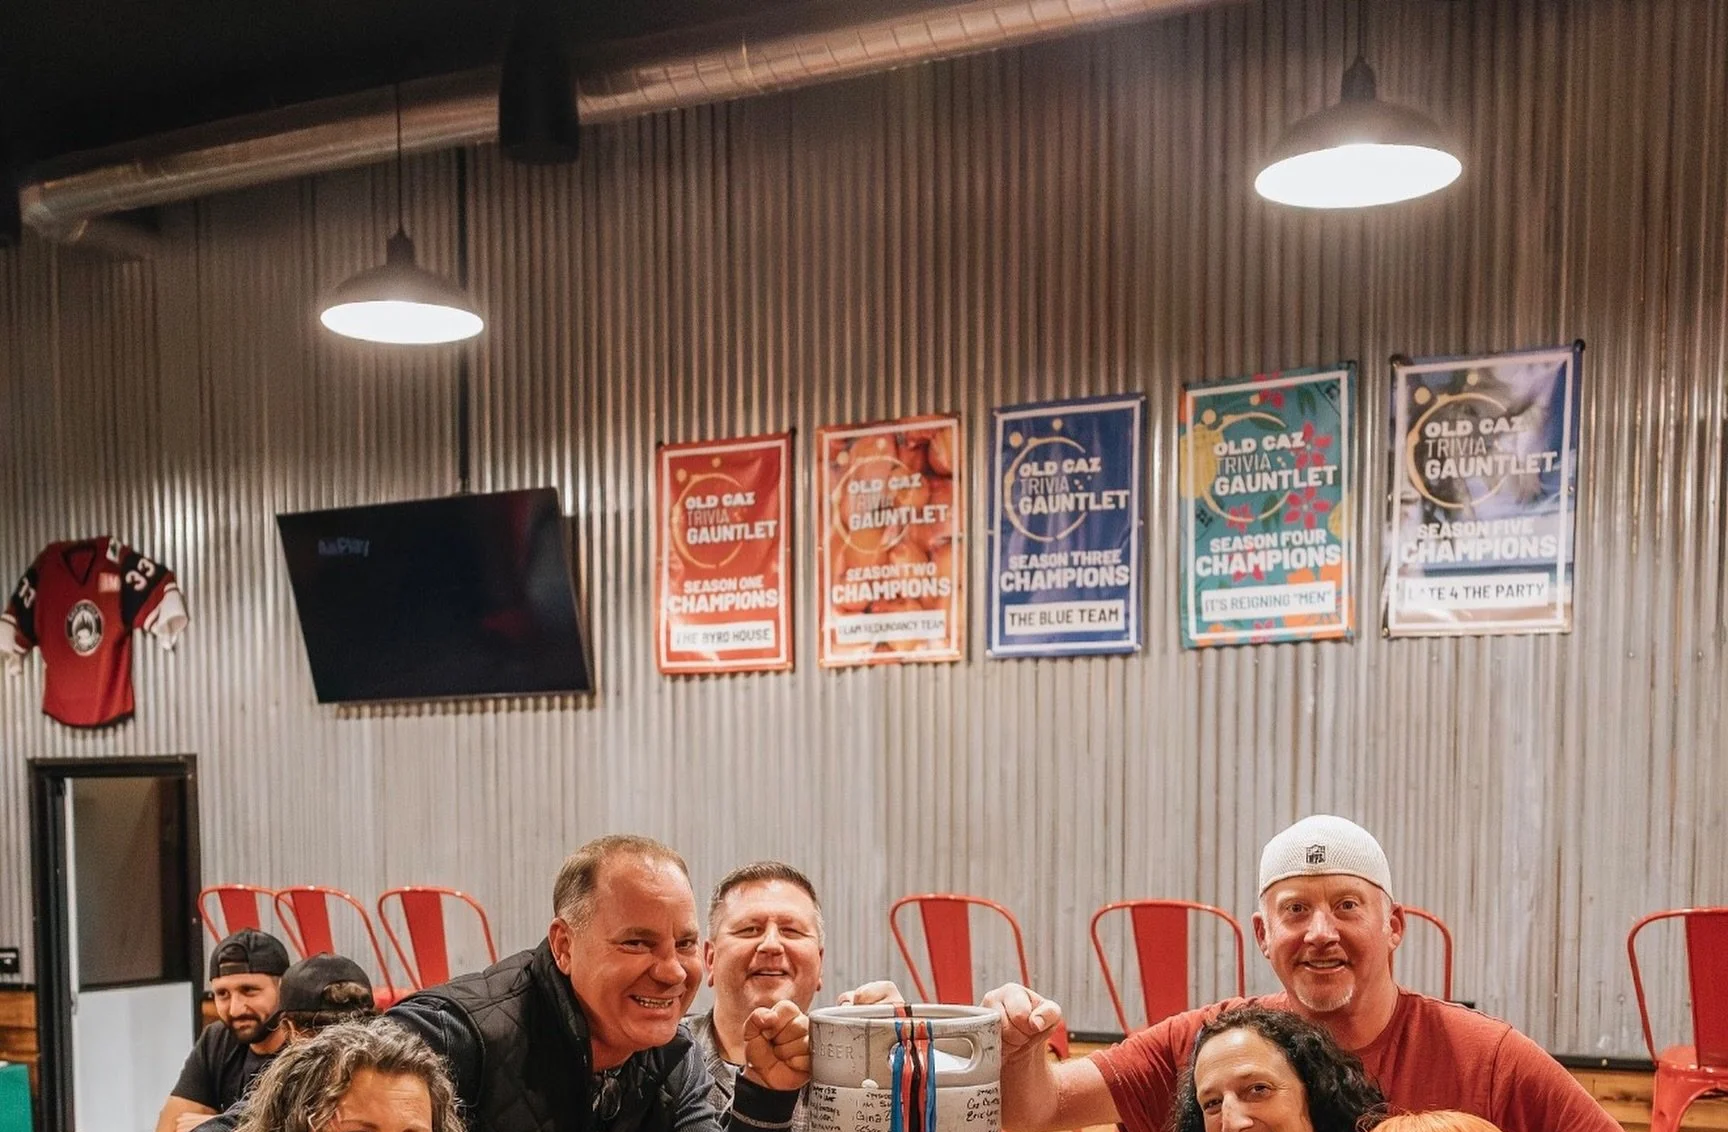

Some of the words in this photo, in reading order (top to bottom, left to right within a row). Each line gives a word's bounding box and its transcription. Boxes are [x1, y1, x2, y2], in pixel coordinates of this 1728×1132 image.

[1425, 419, 1473, 438] OLD
[1214, 437, 1257, 456] OLD
[1262, 432, 1305, 451] CAZ
[1425, 436, 1487, 459] TRIVIA
[1019, 460, 1057, 477] OLD
[1216, 452, 1271, 475] TRIVIA
[1425, 452, 1557, 480] GAUNTLET
[848, 479, 883, 494] OLD
[1020, 476, 1070, 495] TRIVIA
[1214, 465, 1337, 496] GAUNTLET
[685, 494, 718, 509] OLD
[1019, 490, 1129, 515] GAUNTLET
[687, 508, 730, 526] TRIVIA
[849, 504, 948, 531] GAUNTLET
[687, 520, 777, 545] GAUNTLET
[1417, 521, 1488, 540] SEASON
[1491, 518, 1534, 536] FIVE
[1210, 532, 1279, 553] SEASON
[1281, 529, 1327, 546] FOUR
[1402, 536, 1557, 564] CHAMPIONS
[1009, 552, 1069, 570] SEASON
[1071, 549, 1122, 566] THREE
[1196, 544, 1341, 577] CHAMPIONS
[125, 558, 155, 591] 33
[847, 564, 897, 581] SEASON
[900, 562, 937, 577] TWO
[1001, 566, 1129, 592] CHAMPIONS
[684, 577, 736, 594] SEASON
[740, 574, 764, 589] ONE
[832, 576, 952, 605] CHAMPIONS
[1408, 587, 1446, 600] LTE
[1450, 586, 1458, 600] 4
[1463, 585, 1491, 599] THE
[1495, 583, 1544, 598] PARTY
[669, 588, 778, 615] CHAMPIONS
[1204, 597, 1228, 613] IT'S
[1231, 593, 1290, 610] REIGNING
[1009, 611, 1036, 627] THE
[1040, 609, 1073, 625] BLUE
[1080, 607, 1119, 623] TEAM
[733, 628, 770, 641] HOUSE
